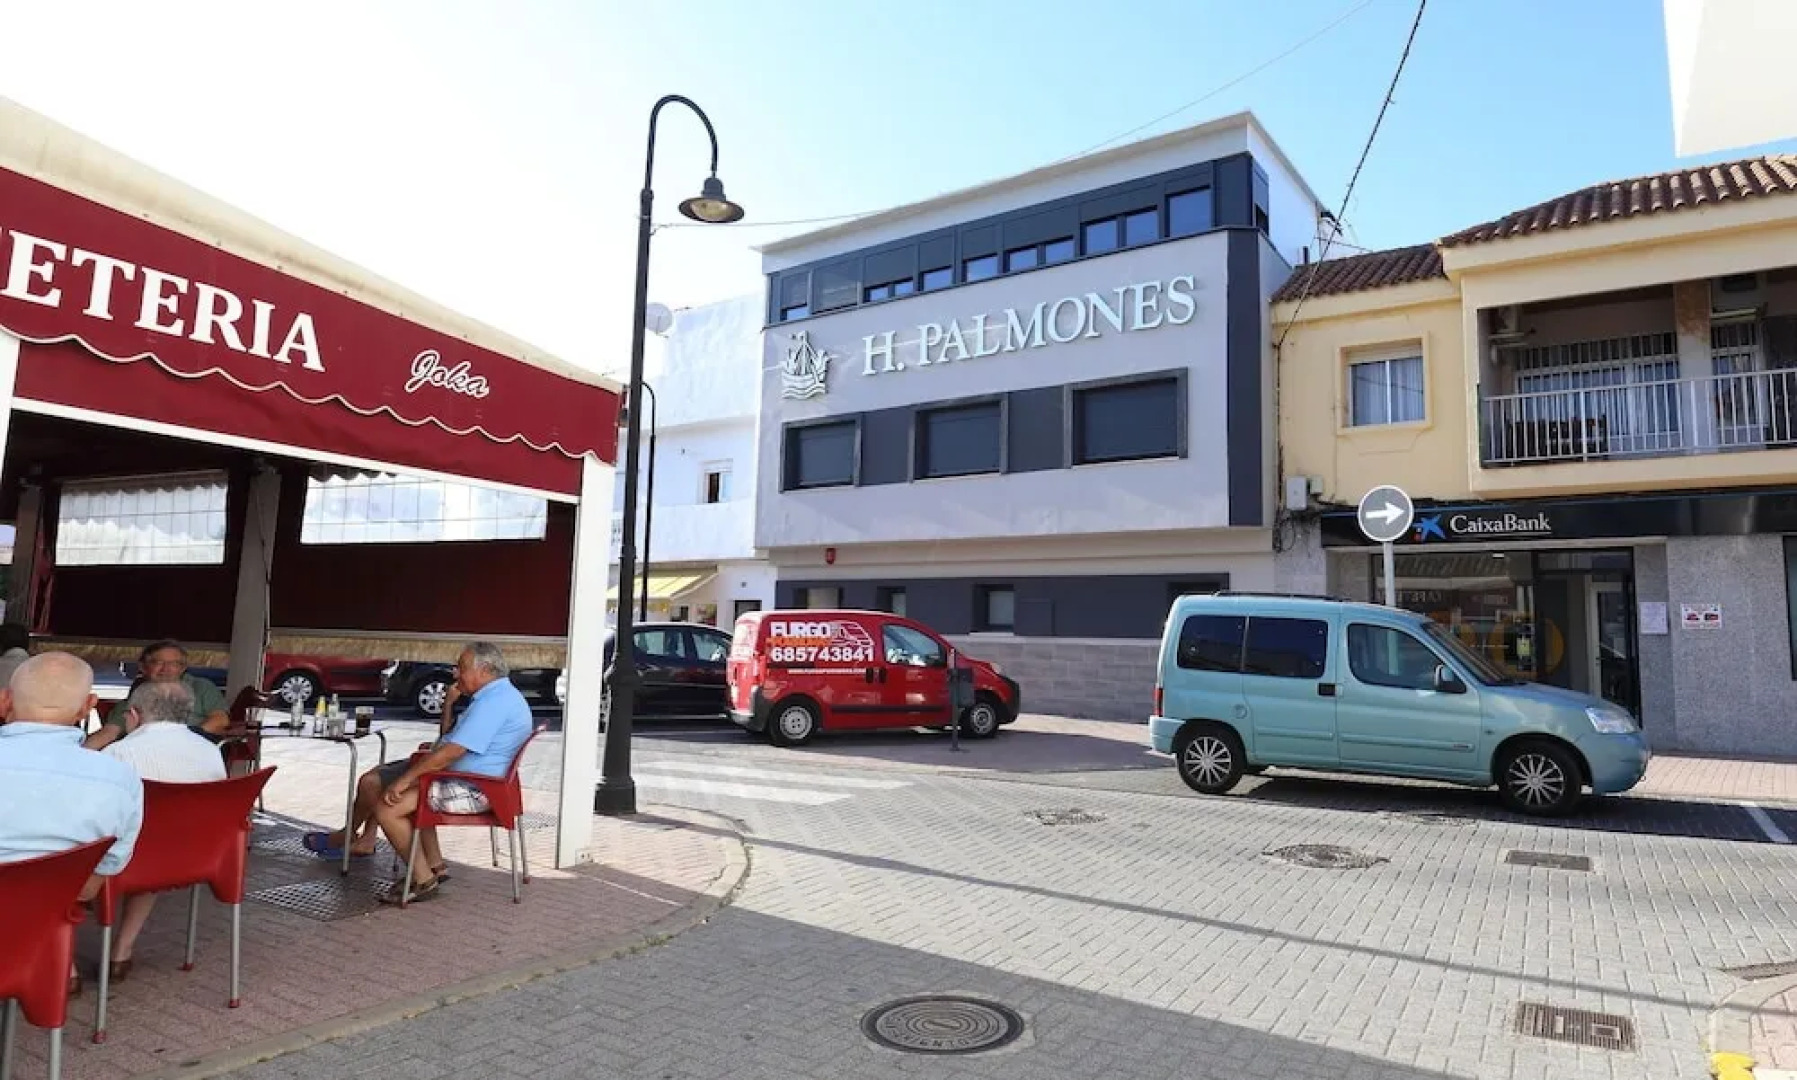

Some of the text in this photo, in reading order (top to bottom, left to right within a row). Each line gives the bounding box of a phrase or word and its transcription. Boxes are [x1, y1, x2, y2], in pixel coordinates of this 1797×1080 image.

[0, 226, 326, 373] ETERIA
[862, 274, 1197, 377] H. PALMONES
[404, 348, 490, 400] Joka
[1449, 512, 1552, 535] CaixaBank
[770, 621, 831, 638] FURGO
[771, 646, 875, 662] 685743841
